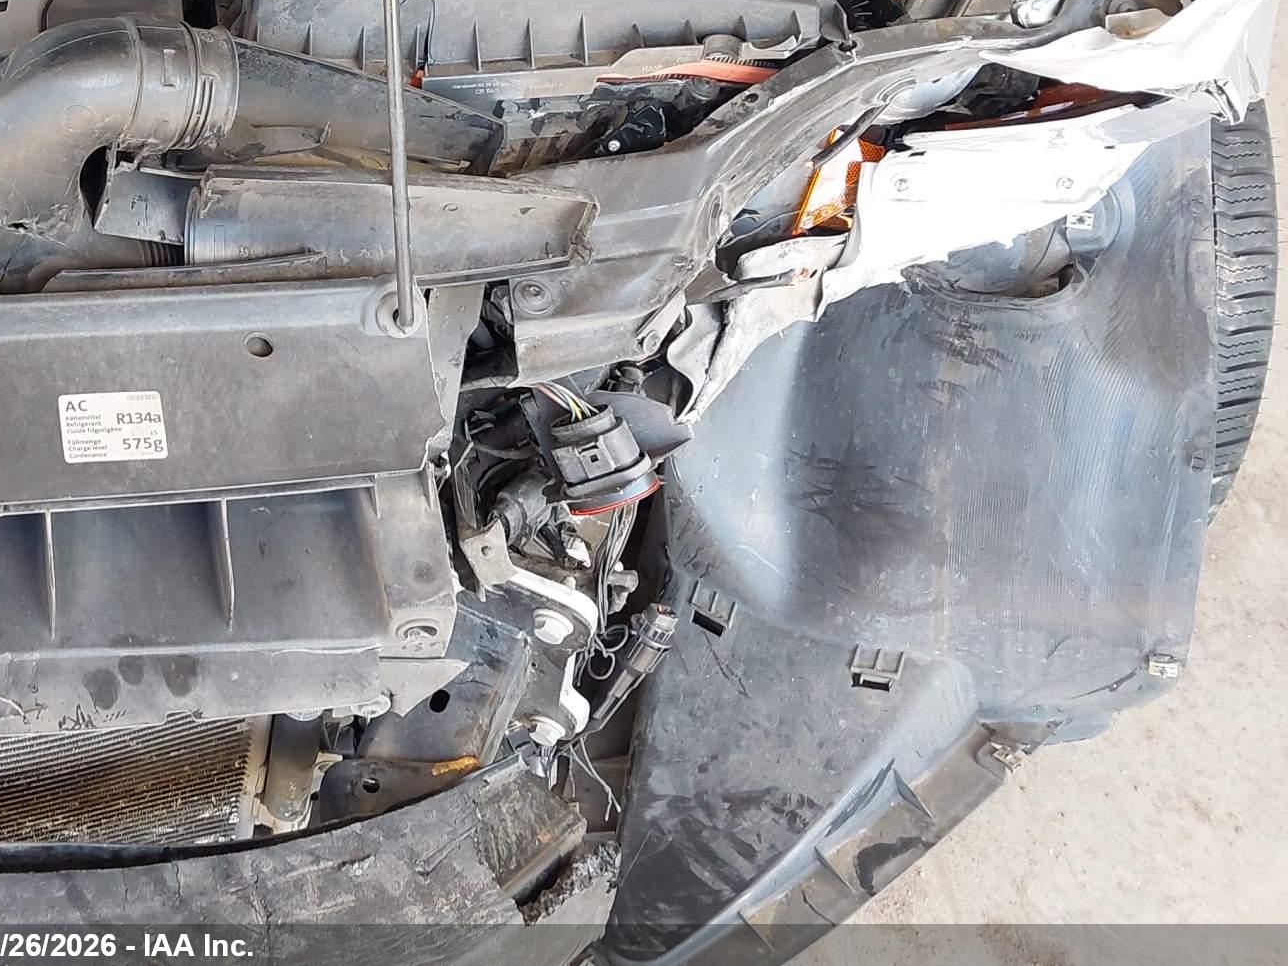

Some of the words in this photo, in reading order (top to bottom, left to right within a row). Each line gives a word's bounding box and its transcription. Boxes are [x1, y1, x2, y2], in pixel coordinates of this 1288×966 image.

[65, 400, 88, 413] AC
[116, 412, 162, 424] R134a
[122, 437, 164, 453] 575g
